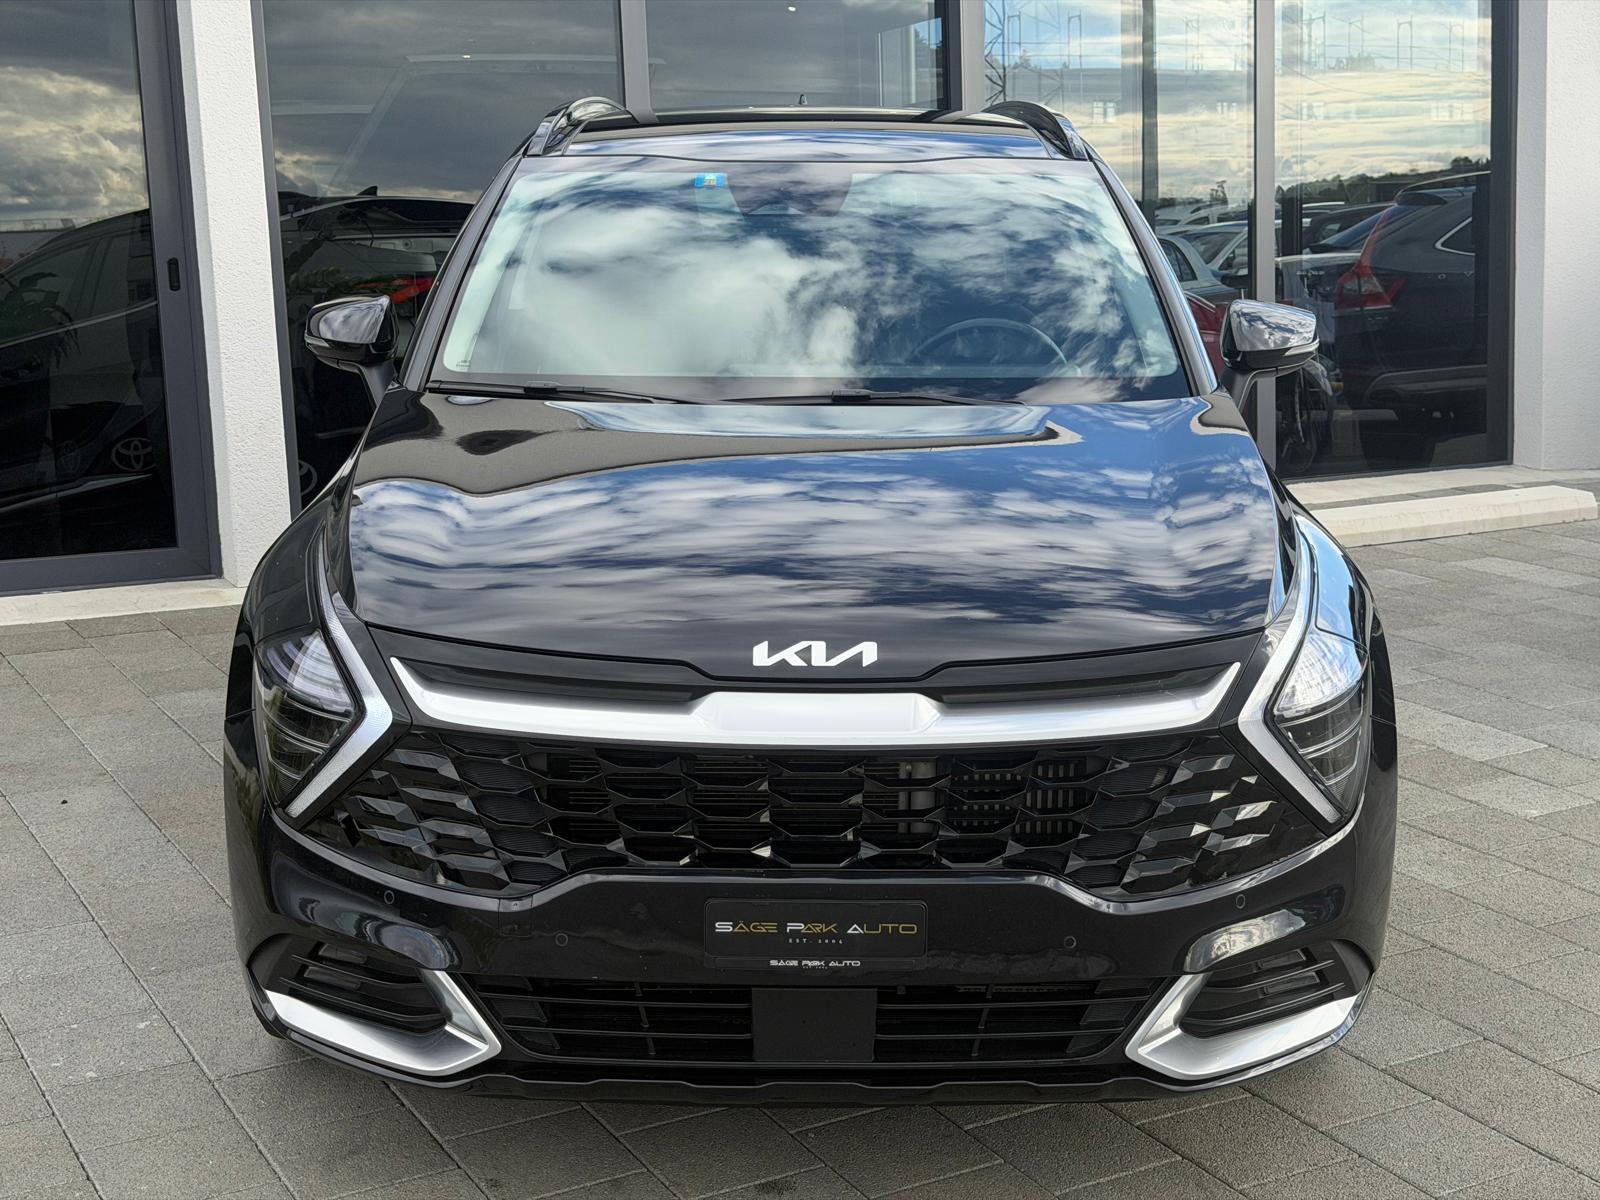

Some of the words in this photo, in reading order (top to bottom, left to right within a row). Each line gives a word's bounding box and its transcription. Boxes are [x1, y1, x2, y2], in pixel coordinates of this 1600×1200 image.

[752, 640, 878, 667] KIA
[786, 922, 838, 933] PARK
[846, 923, 917, 934] AUTO
